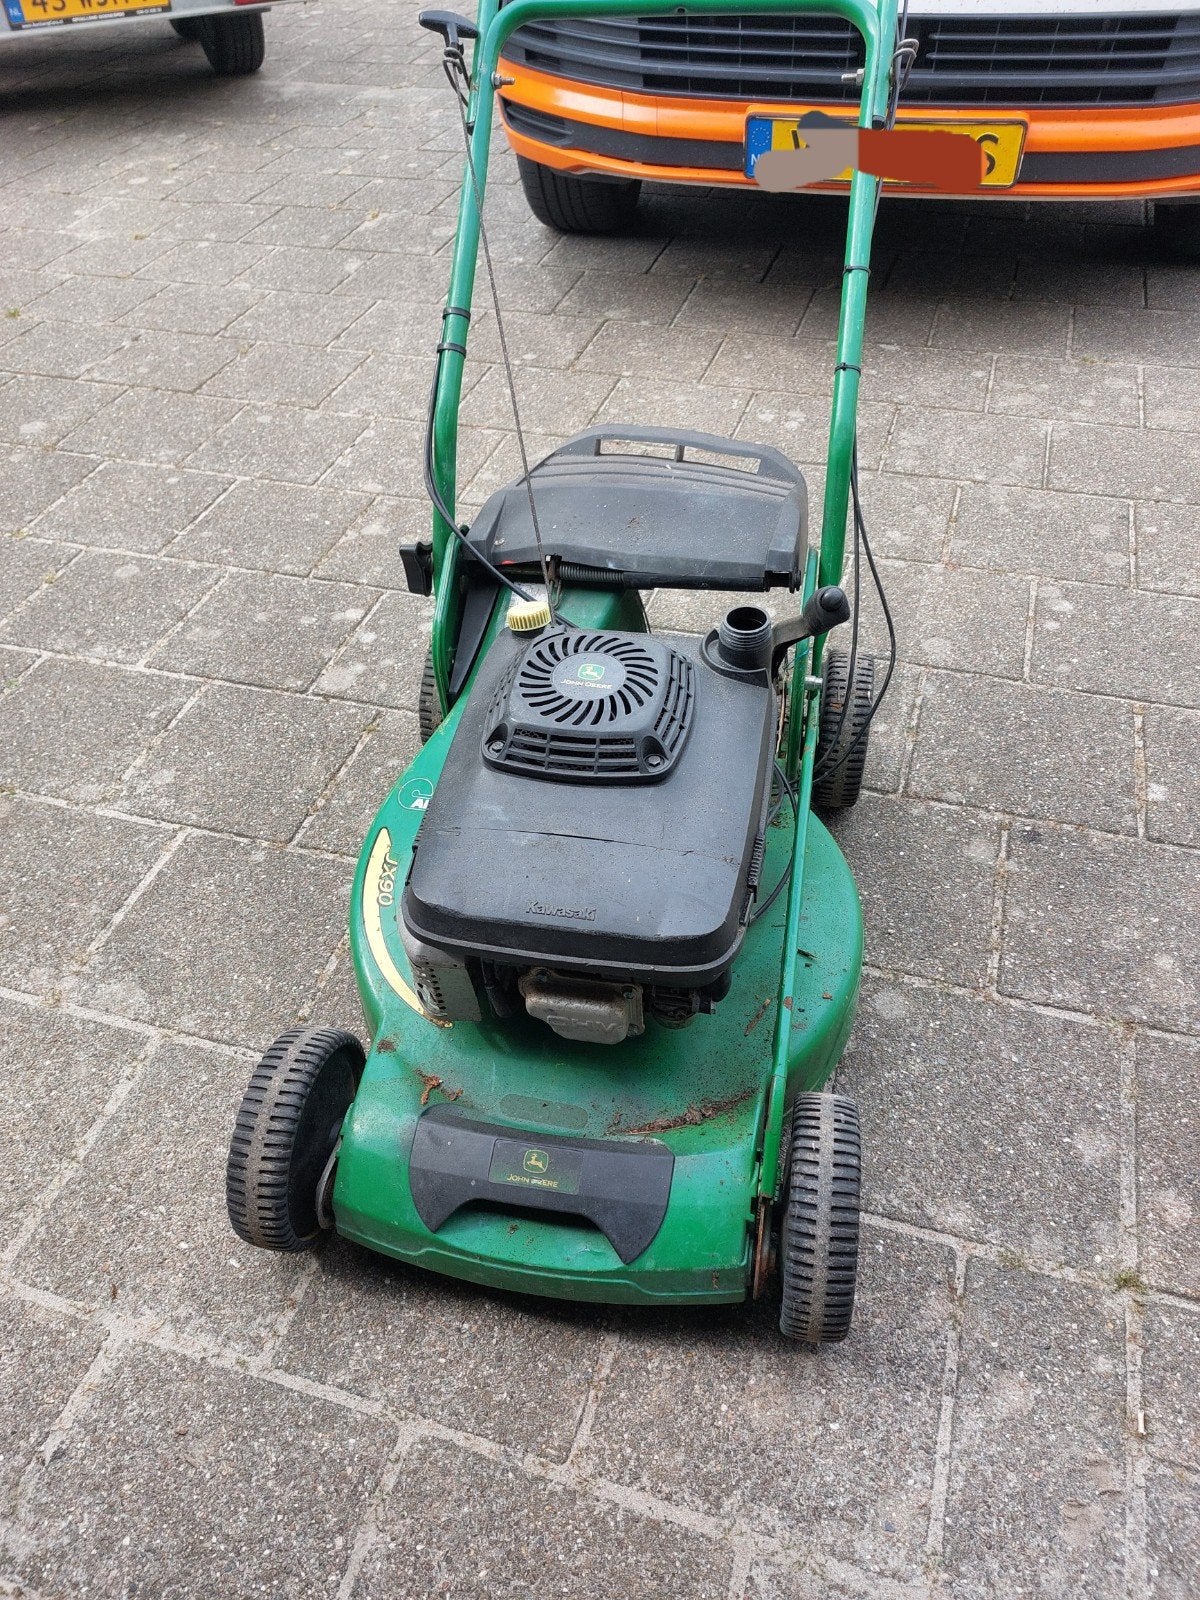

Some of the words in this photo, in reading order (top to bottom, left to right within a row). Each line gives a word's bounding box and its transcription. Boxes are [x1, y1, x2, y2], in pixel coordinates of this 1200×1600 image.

[8, 7, 22, 16] NL
[560, 678, 584, 686] JOHN
[585, 681, 613, 690] DEERE
[376, 852, 398, 906] JX90
[525, 901, 597, 922] Kawasaki
[506, 1173, 530, 1184] JOHN
